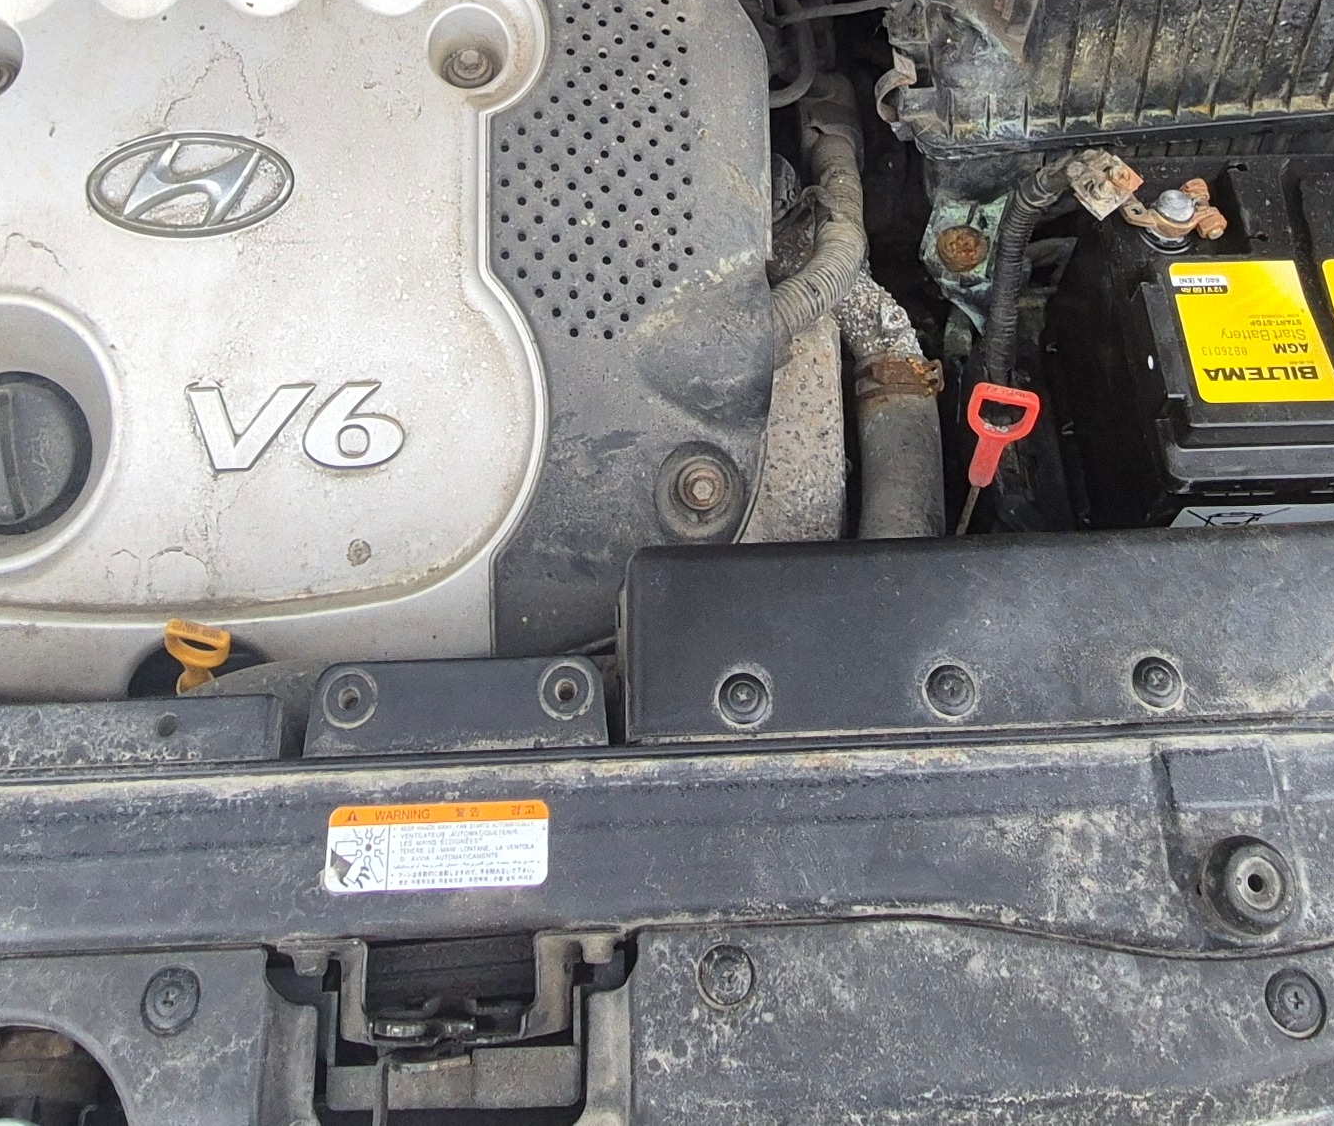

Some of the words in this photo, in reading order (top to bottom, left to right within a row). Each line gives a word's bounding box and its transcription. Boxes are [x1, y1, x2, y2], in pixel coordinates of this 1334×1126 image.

[1220, 327, 1270, 341] Battery
[1272, 328, 1306, 341] Start
[1272, 343, 1309, 354] AGM
[1202, 366, 1319, 382] BILTEMA
[185, 381, 405, 474] V6
[374, 808, 431, 822] WARNING
